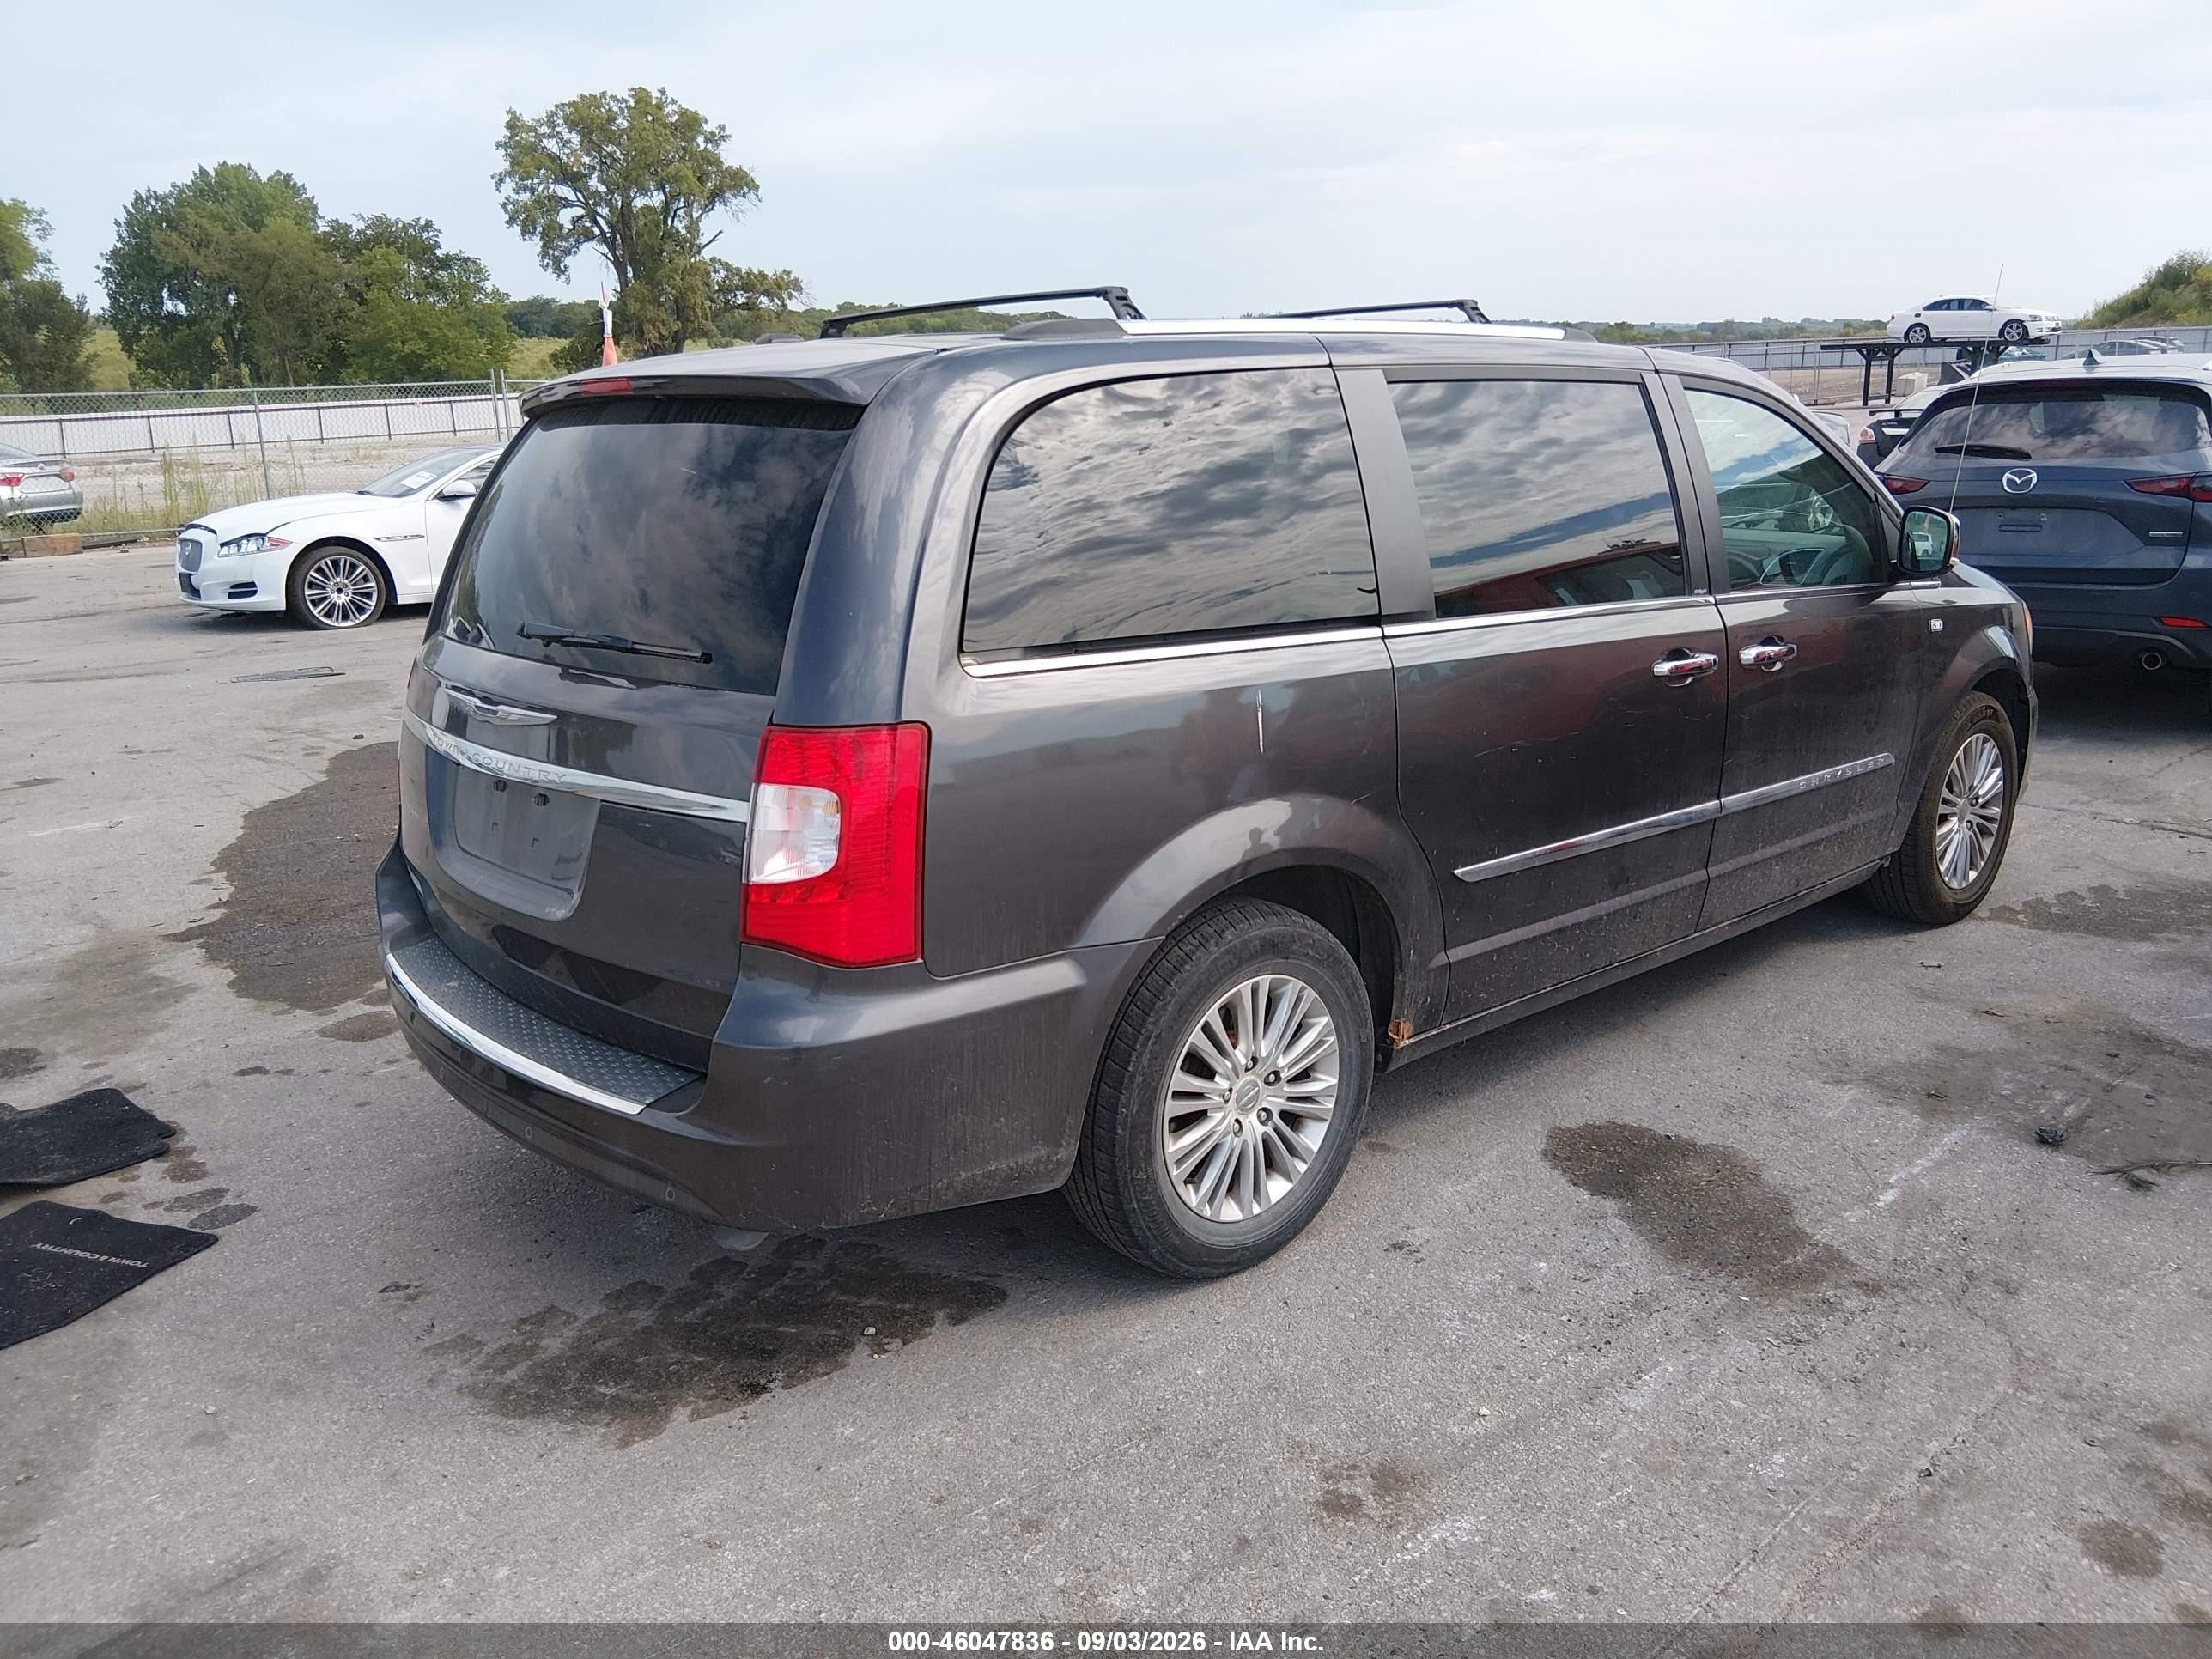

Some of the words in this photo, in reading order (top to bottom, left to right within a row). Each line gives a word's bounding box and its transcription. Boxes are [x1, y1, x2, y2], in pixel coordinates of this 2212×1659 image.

[472, 752, 566, 784] COUNTRY
[1800, 757, 1884, 788] CHRYSLER
[31, 1243, 100, 1259] COUNTRY
[108, 1257, 149, 1267] TOWN
